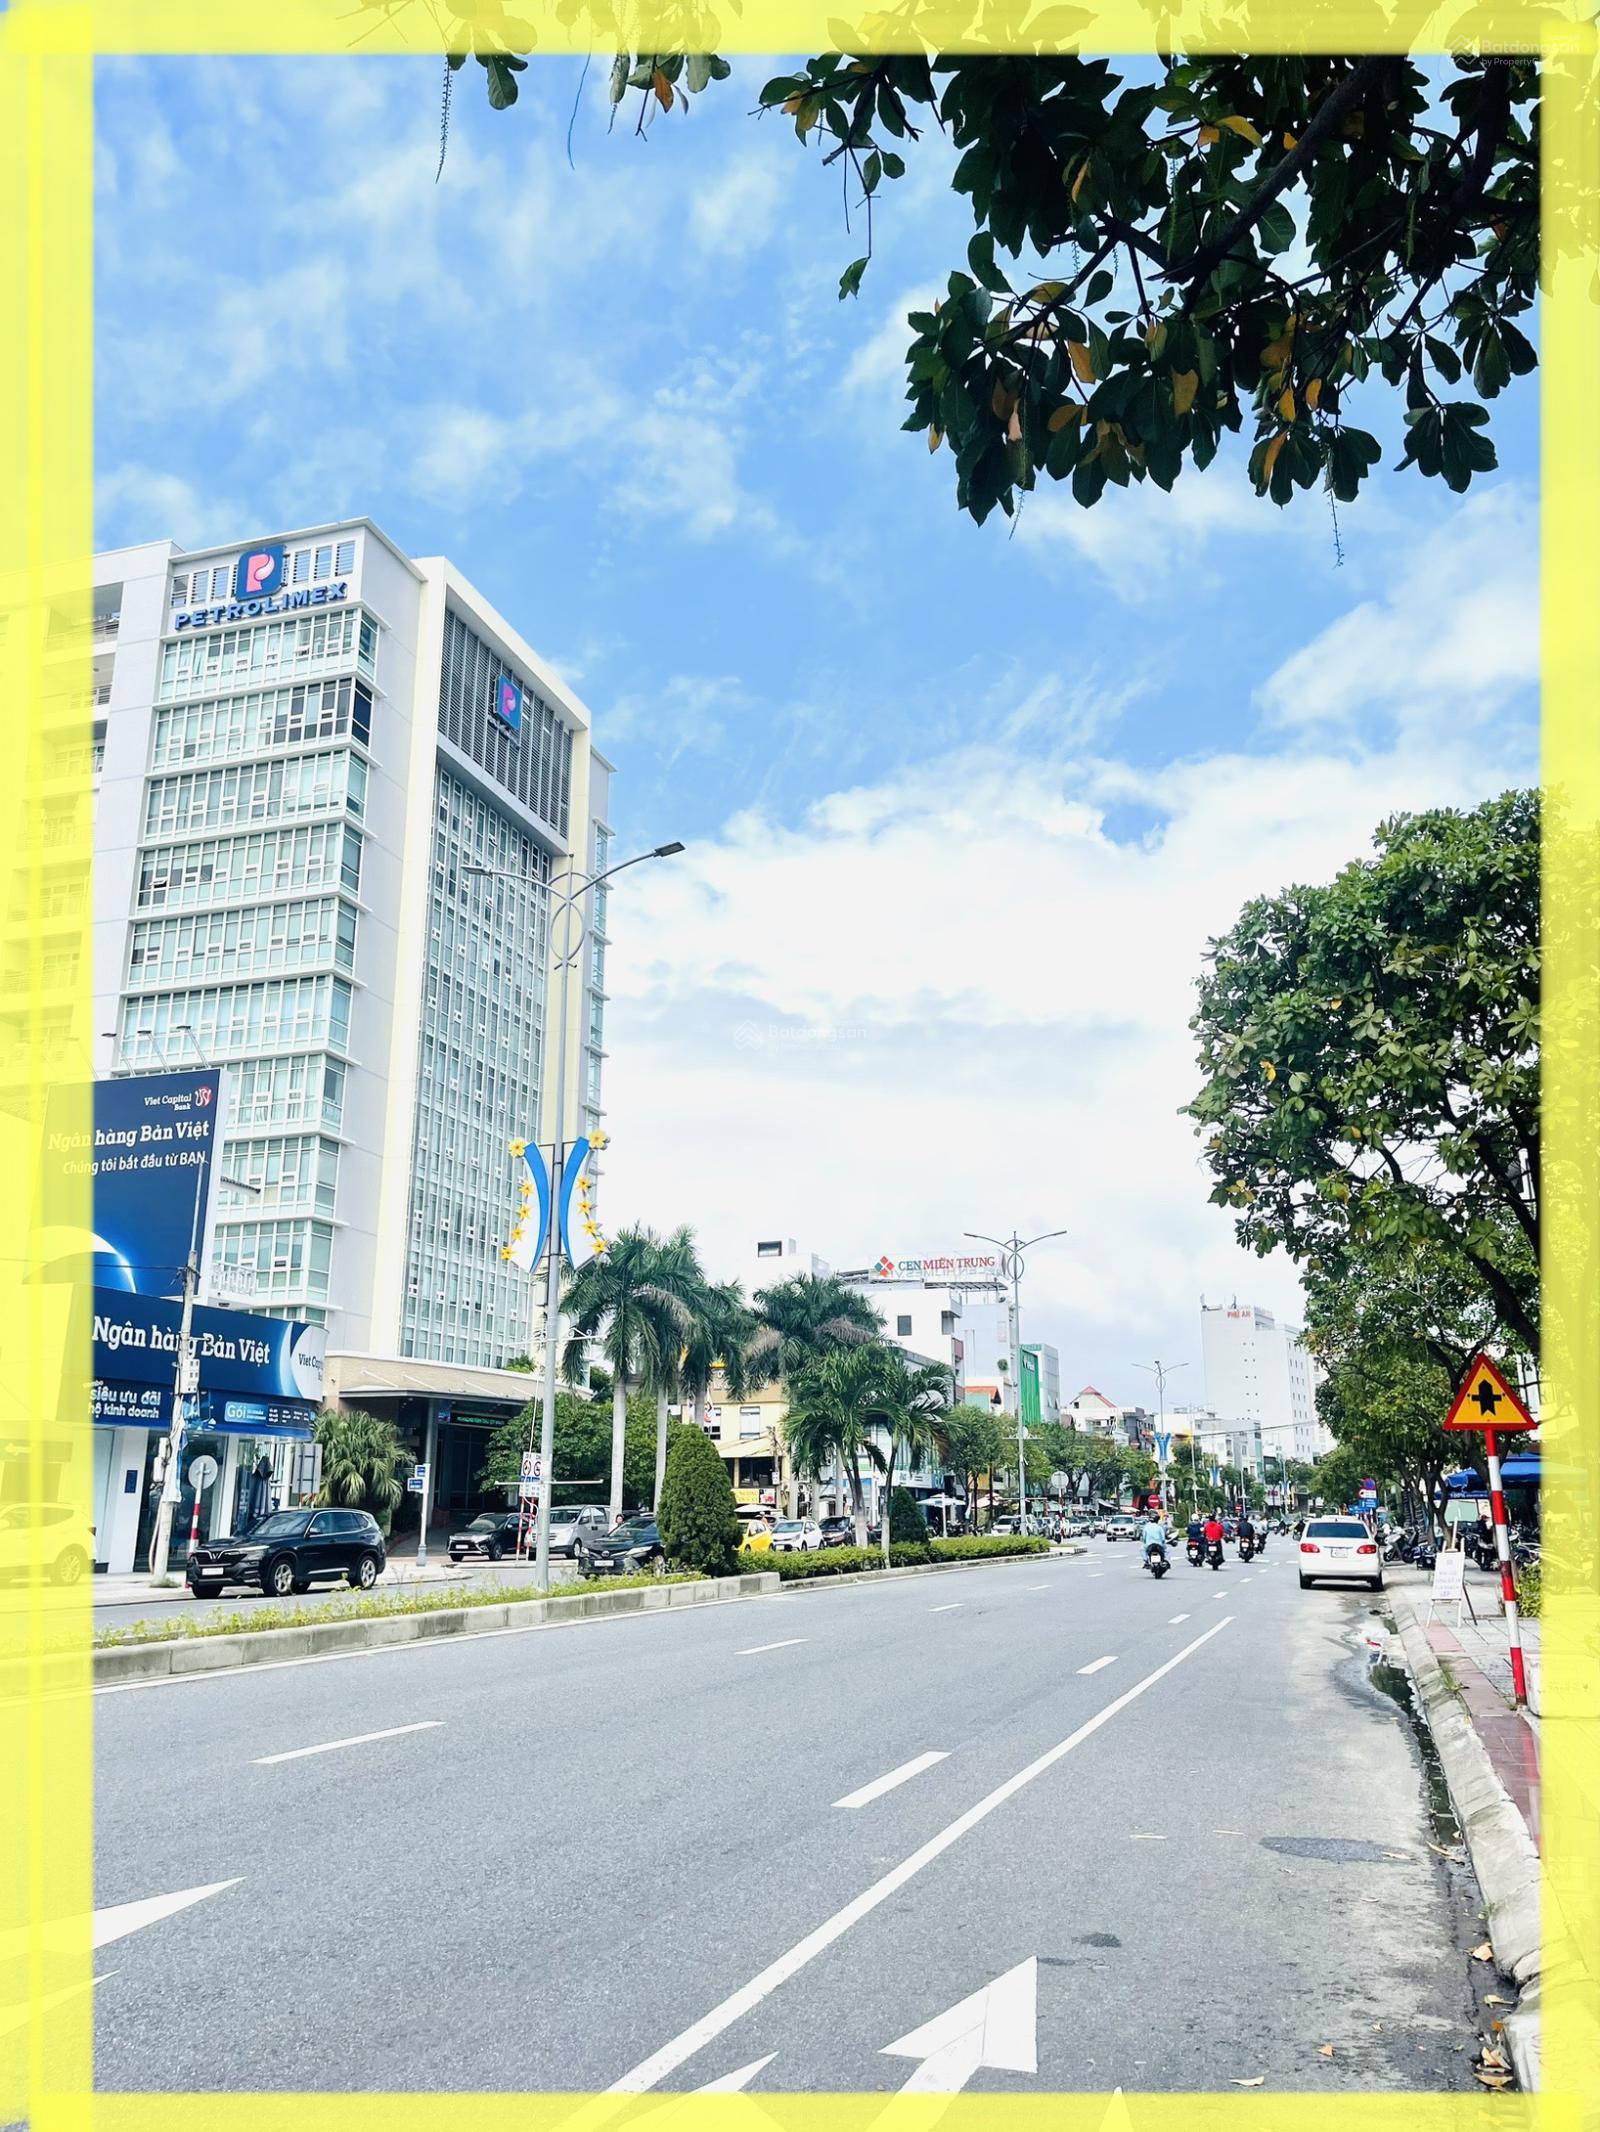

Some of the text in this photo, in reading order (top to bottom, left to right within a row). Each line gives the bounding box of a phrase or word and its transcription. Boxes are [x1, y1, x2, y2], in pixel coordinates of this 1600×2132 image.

[175, 582, 348, 630] PETROLIMEX
[144, 1093, 192, 1106] Viet Capital
[174, 1103, 191, 1111] Bank
[95, 1128, 137, 1147] hàng
[140, 1124, 173, 1141] Bản
[175, 1120, 209, 1141] Việt
[63, 1159, 98, 1176] Chúng
[101, 1156, 117, 1172] tôi
[141, 1153, 163, 1169] đầu
[165, 1152, 179, 1167] từ
[180, 1151, 205, 1169] BẠN
[898, 1260, 921, 1271] CEN
[957, 1256, 995, 1269] TRUNG
[92, 1315, 146, 1350] Ngân
[201, 1332, 236, 1360] Bản
[239, 1338, 270, 1368] Việt
[90, 1386, 117, 1402] siêu
[140, 1390, 161, 1406] đãi
[103, 1403, 126, 1416] kinh
[127, 1404, 160, 1419] doanh
